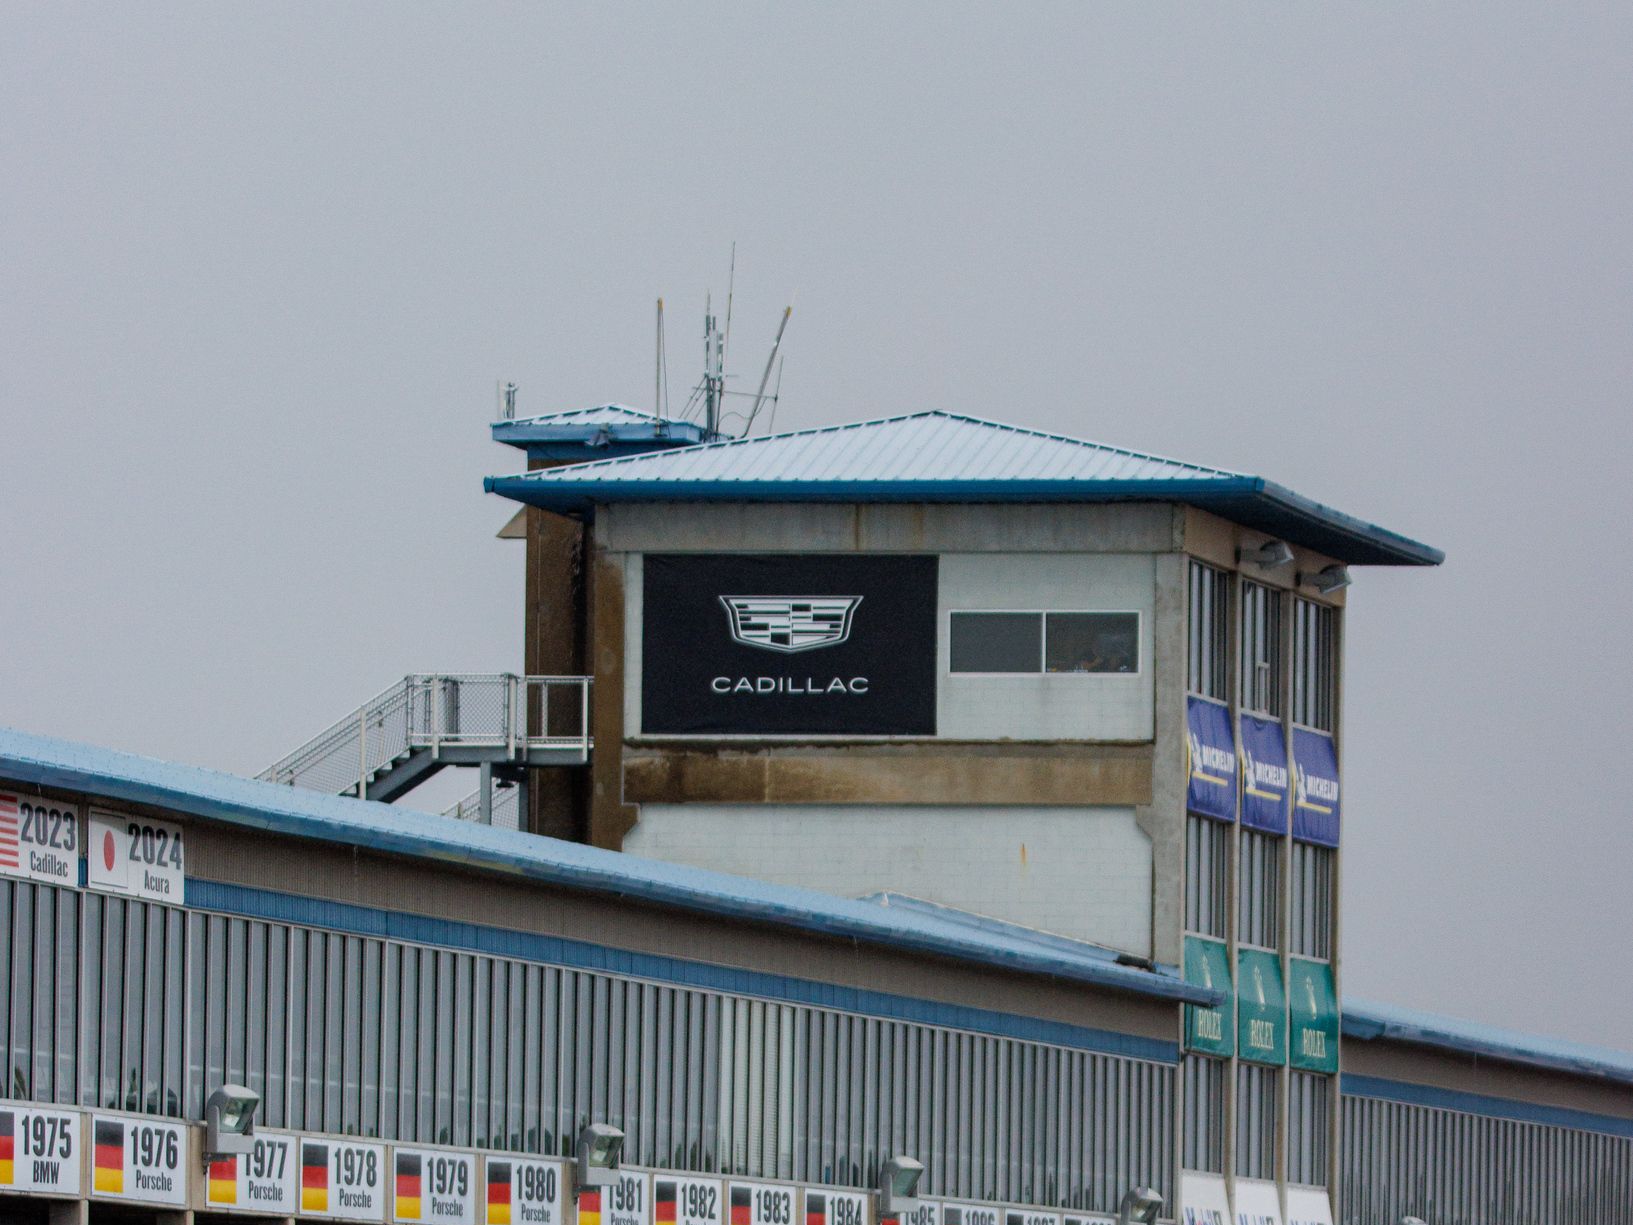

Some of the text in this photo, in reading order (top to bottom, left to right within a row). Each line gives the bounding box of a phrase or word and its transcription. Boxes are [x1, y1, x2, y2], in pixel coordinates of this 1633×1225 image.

[712, 677, 869, 693] CADILLAC
[1202, 745, 1235, 773] MICHELIN
[1256, 761, 1287, 788] MICHELIN
[1306, 774, 1339, 801] MICHELIN
[20, 802, 76, 851] 2023
[128, 822, 182, 870] 2024
[30, 850, 68, 878] Cadillac
[144, 869, 170, 894] Acura
[1198, 1010, 1222, 1040] ROLEX
[1251, 1020, 1274, 1049] ROLEX
[1303, 1029, 1326, 1058] ROLEX
[21, 1115, 72, 1159] 1975
[131, 1126, 178, 1170] 1976
[32, 1160, 60, 1185] BMW
[245, 1139, 288, 1179] 1977
[334, 1147, 377, 1187] 1978
[136, 1170, 172, 1192] Porsche
[248, 1180, 283, 1201] Porsche
[427, 1157, 468, 1196] 1979
[516, 1165, 556, 1203] 1980
[339, 1188, 372, 1208] Porsche
[432, 1197, 463, 1217] Porsche
[609, 1176, 642, 1212] 1981
[681, 1183, 716, 1220] 1982
[756, 1189, 790, 1225] 1983
[521, 1203, 550, 1223] Porsche
